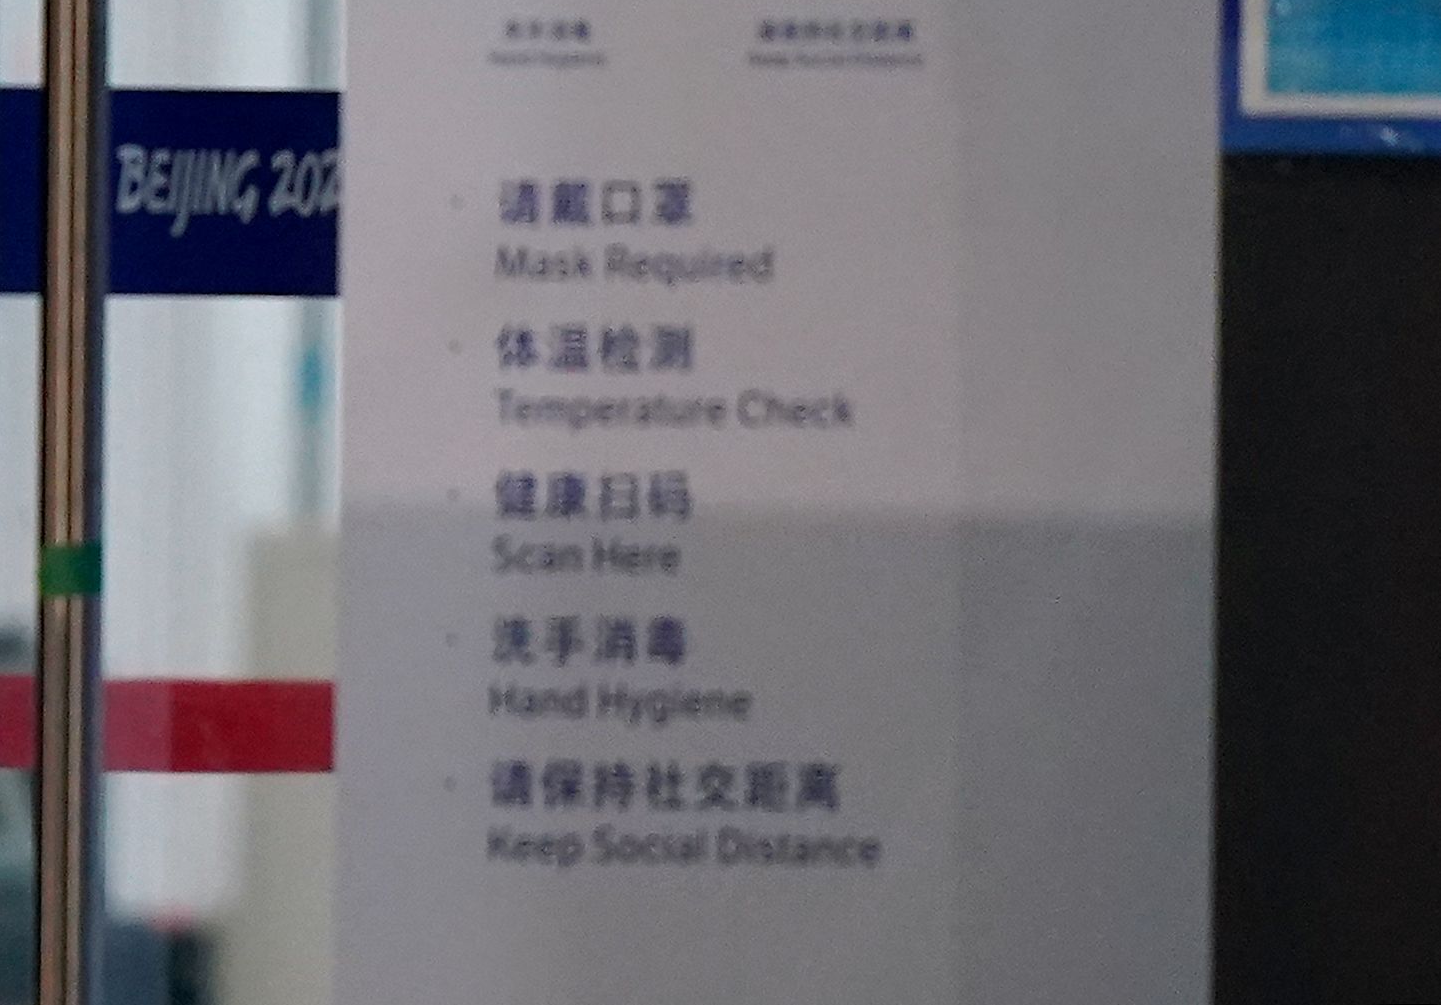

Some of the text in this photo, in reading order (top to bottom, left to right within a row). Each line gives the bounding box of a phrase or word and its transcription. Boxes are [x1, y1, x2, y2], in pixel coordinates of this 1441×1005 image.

[116, 144, 260, 238] BEIJING
[494, 243, 775, 285] Mask Required
[495, 387, 855, 433] Temperature Check
[491, 534, 682, 575] Scan Here
[488, 685, 753, 727] Hand Hygiene
[487, 824, 882, 868] Keep Social Distance
